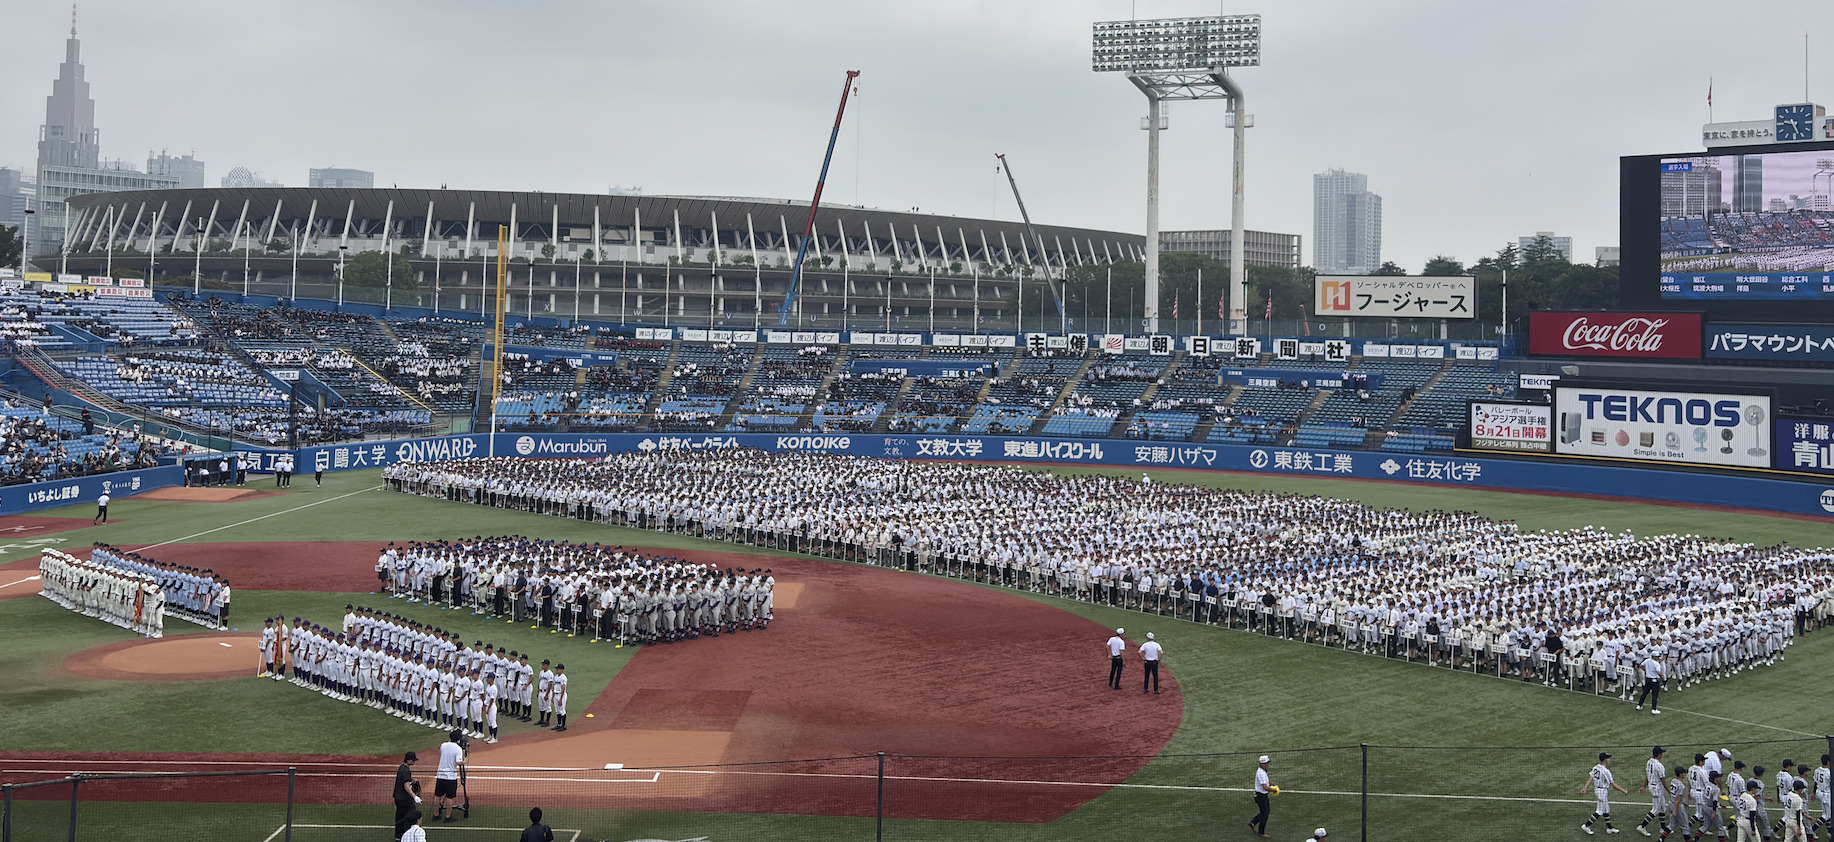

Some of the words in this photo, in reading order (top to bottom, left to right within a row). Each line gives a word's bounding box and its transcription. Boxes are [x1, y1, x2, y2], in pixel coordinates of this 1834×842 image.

[1703, 129, 1774, 140] 東京に、家を持とう。
[1356, 291, 1468, 313] フージャース
[1068, 318, 1074, 326] R
[1411, 325, 1418, 333] N
[1562, 317, 1670, 351] Coca-Cola
[1521, 378, 1551, 387] TEKNO
[1491, 406, 1532, 415] バレーボール
[1578, 394, 1741, 427] TEKNOS
[1491, 414, 1547, 426] アジア選手権
[1794, 423, 1834, 440] 洋服
[538, 438, 607, 453] Marubun
[659, 436, 740, 451] 住友ベークライト
[884, 437, 909, 446] 育ての、
[916, 438, 983, 457] 文教大学
[1475, 440, 1519, 449] フジテレビ系列
[396, 437, 477, 462] ONWARD
[884, 447, 903, 456] 文教。
[1003, 440, 1103, 460] 東進ハイスクール
[1135, 445, 1217, 466] 安藤ハザマ
[1634, 449, 1657, 458] Simple
[1667, 451, 1684, 459] Best
[1274, 450, 1353, 473] 東鉄工業
[1405, 458, 1481, 481] 住友化学
[28, 485, 80, 504] いちよし証券
